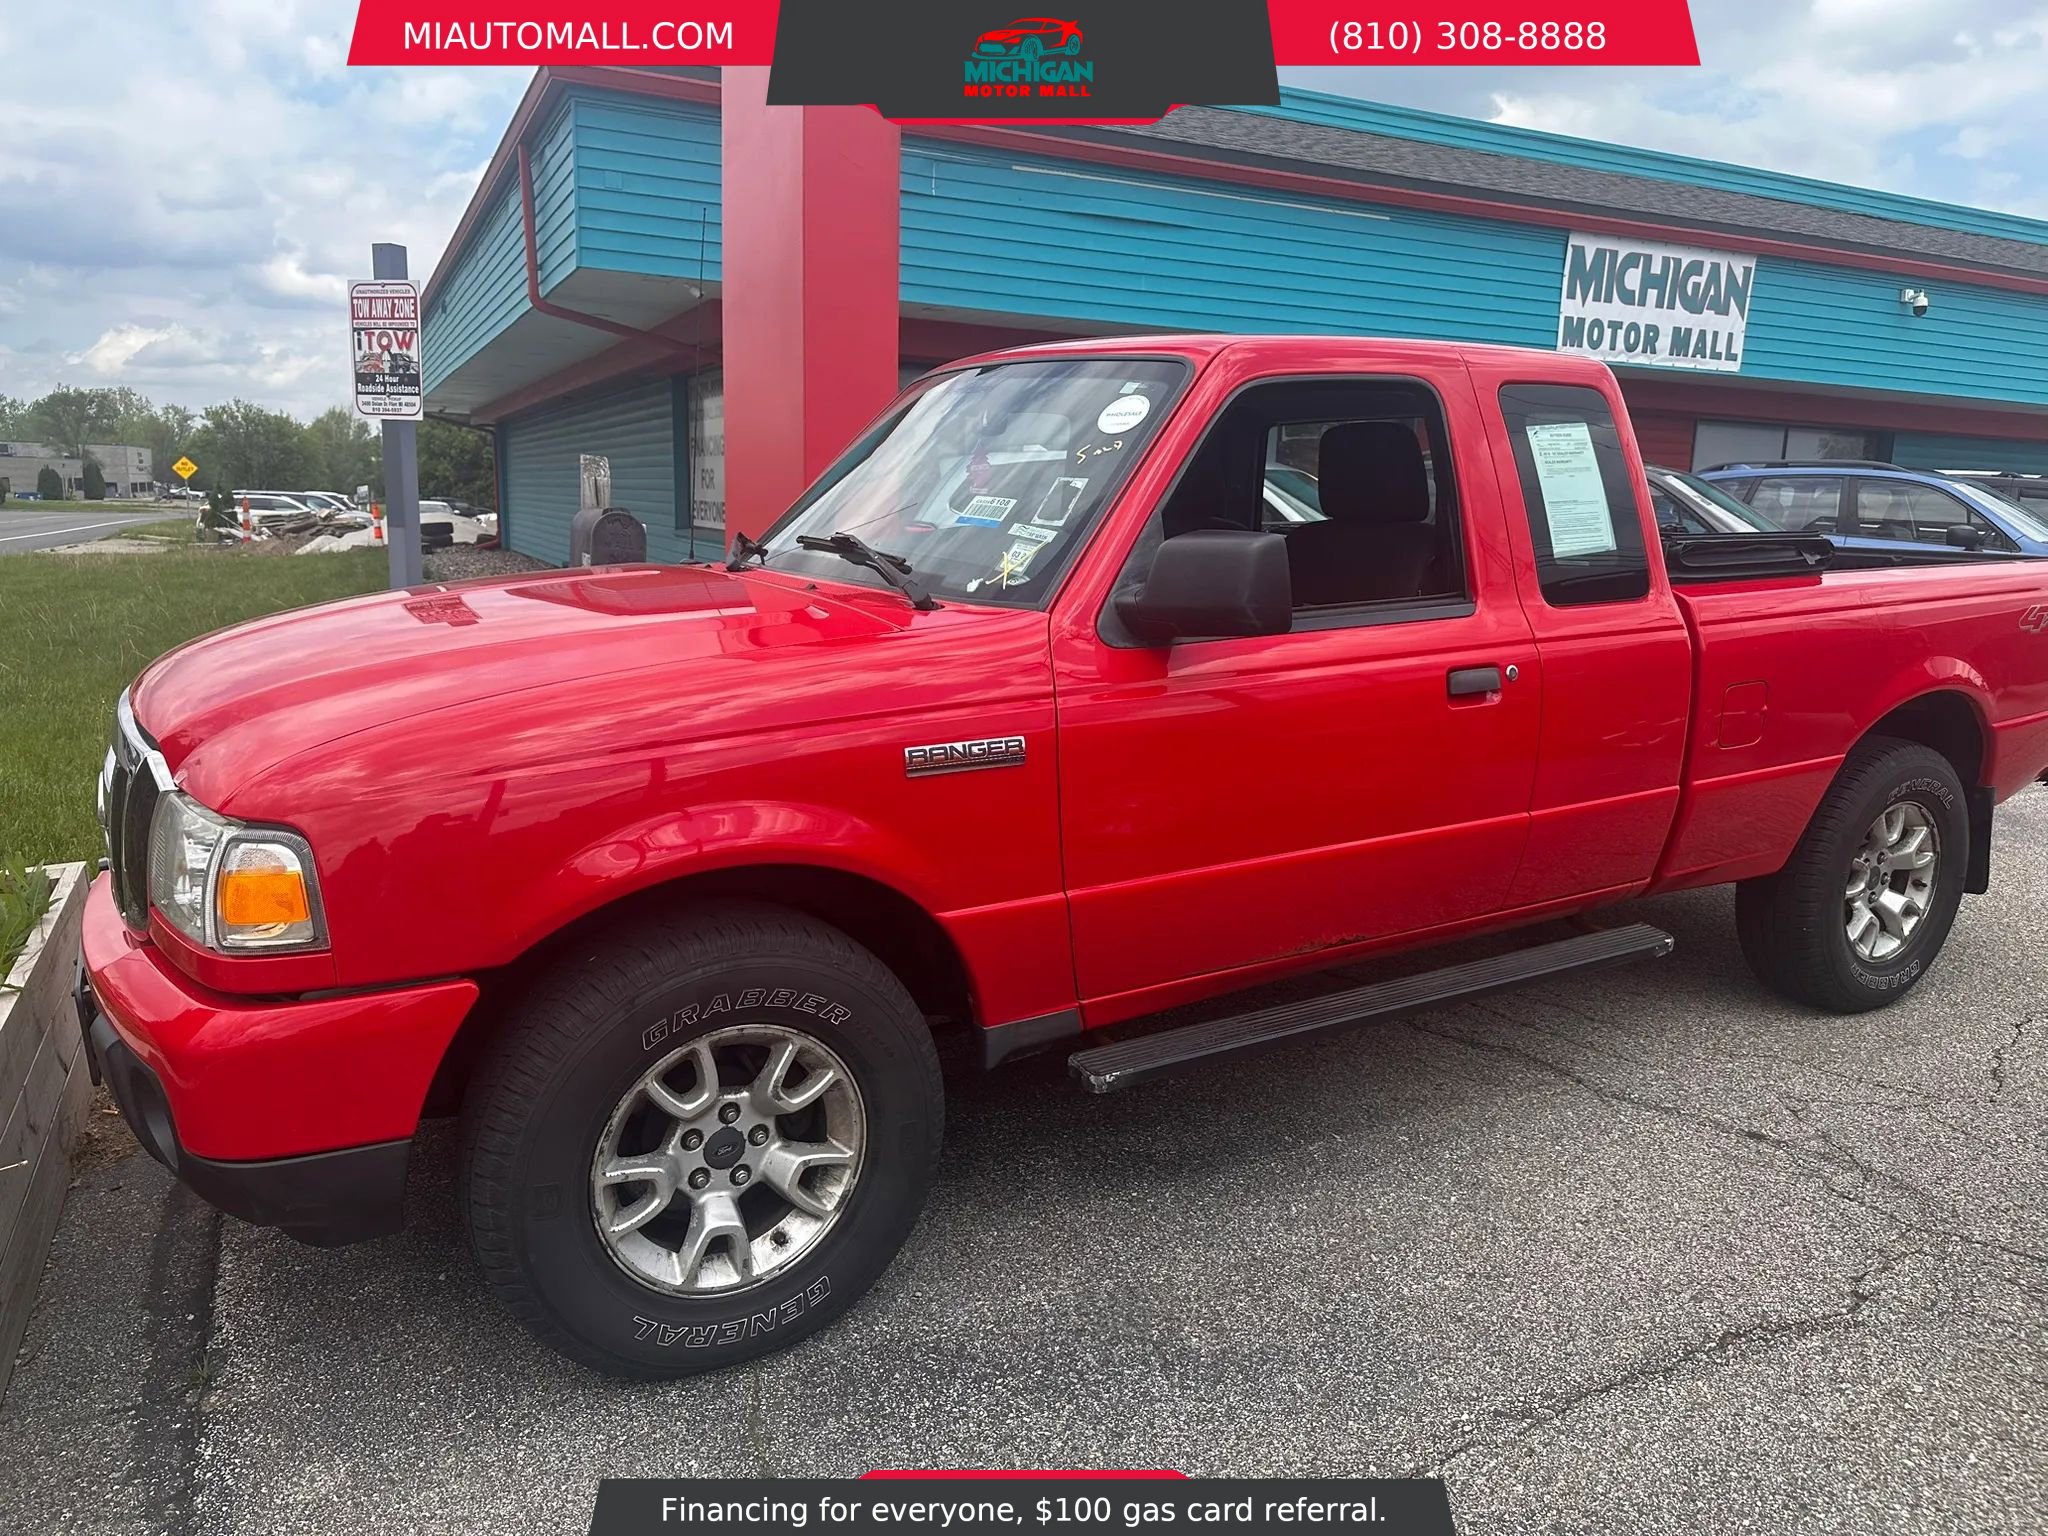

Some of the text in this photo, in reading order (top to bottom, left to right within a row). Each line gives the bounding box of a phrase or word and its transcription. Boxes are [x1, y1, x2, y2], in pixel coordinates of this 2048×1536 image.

[1566, 244, 1753, 322] MICHIGAN
[353, 298, 415, 318] TOW AWAY ZONE
[1562, 316, 1738, 362] MOTOR MALL
[357, 383, 420, 394] Roadside Assistance
[375, 374, 399, 382] 24 Hour
[701, 468, 715, 490] FOR
[907, 738, 1025, 765] RANGER
[1886, 777, 1954, 810] GENERAL
[1850, 959, 1920, 990] GRABBER
[642, 987, 852, 1051] GRABBER
[632, 1275, 833, 1349] GENERAL
